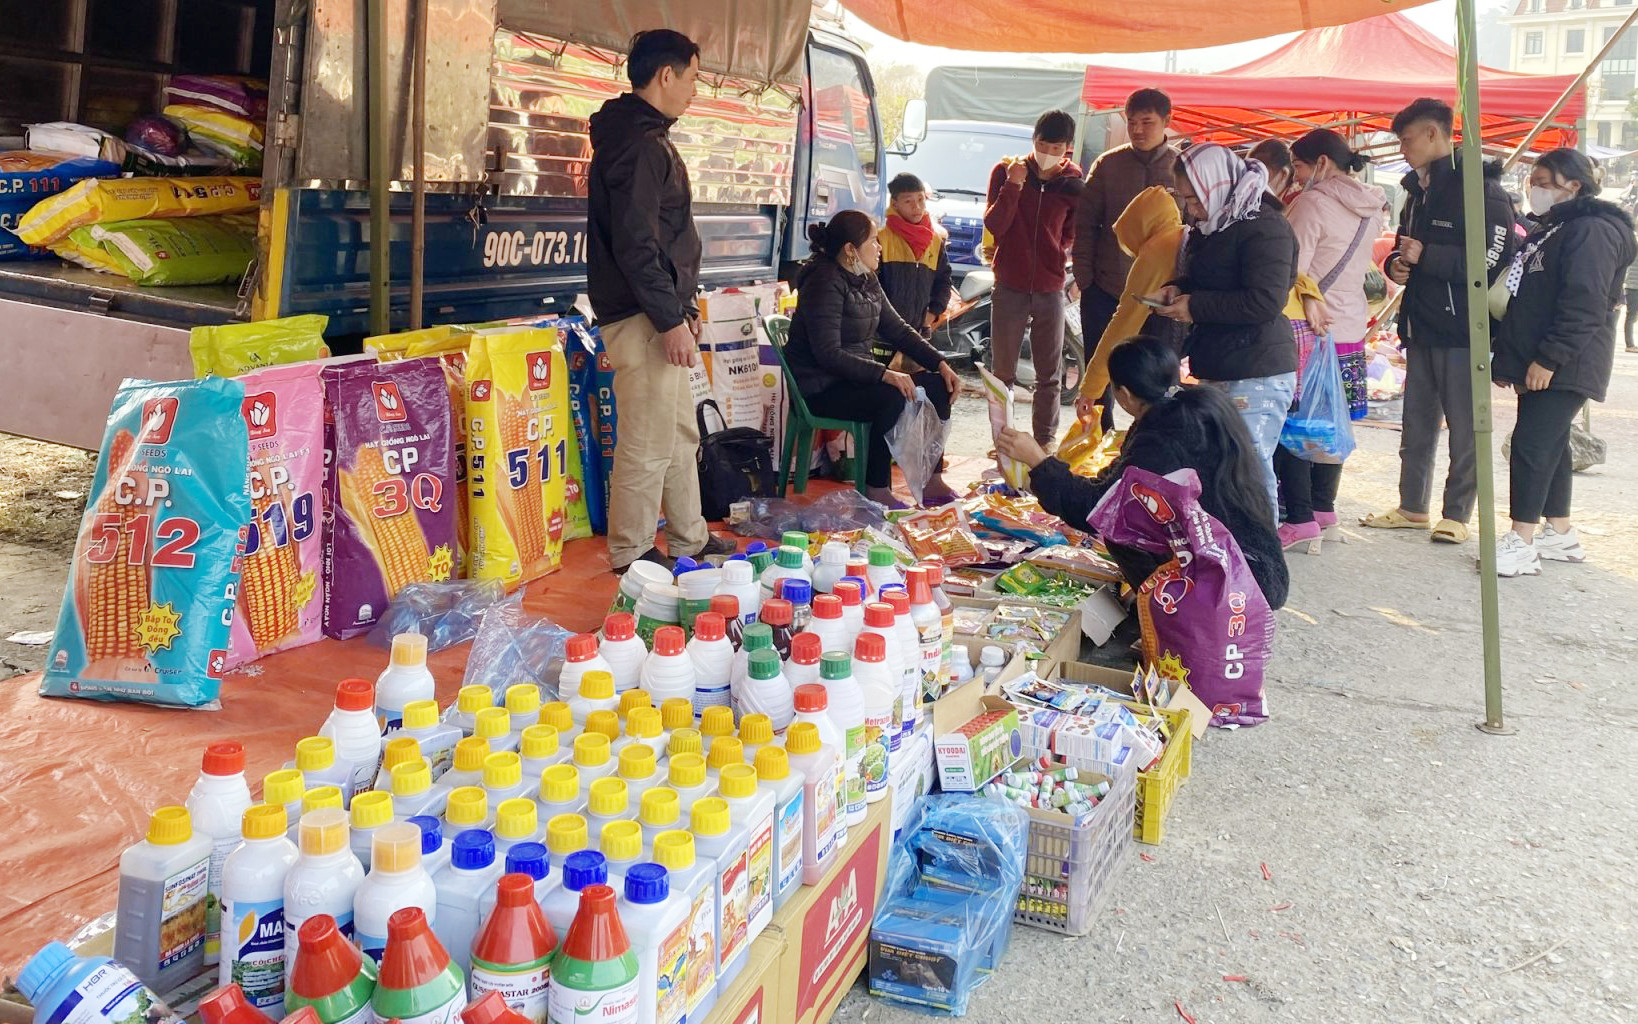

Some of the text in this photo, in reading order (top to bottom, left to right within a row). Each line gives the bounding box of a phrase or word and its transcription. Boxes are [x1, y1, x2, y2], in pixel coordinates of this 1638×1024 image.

[29, 179, 60, 192] 111
[141, 449, 167, 458] SEEDS
[382, 447, 419, 475] CP
[506, 439, 567, 490] 511
[114, 476, 172, 508] C.P.
[371, 472, 443, 518] 3Q
[86, 512, 201, 569] 512
[1225, 591, 1247, 680] CP 3Q
[83, 968, 108, 991] HBR
